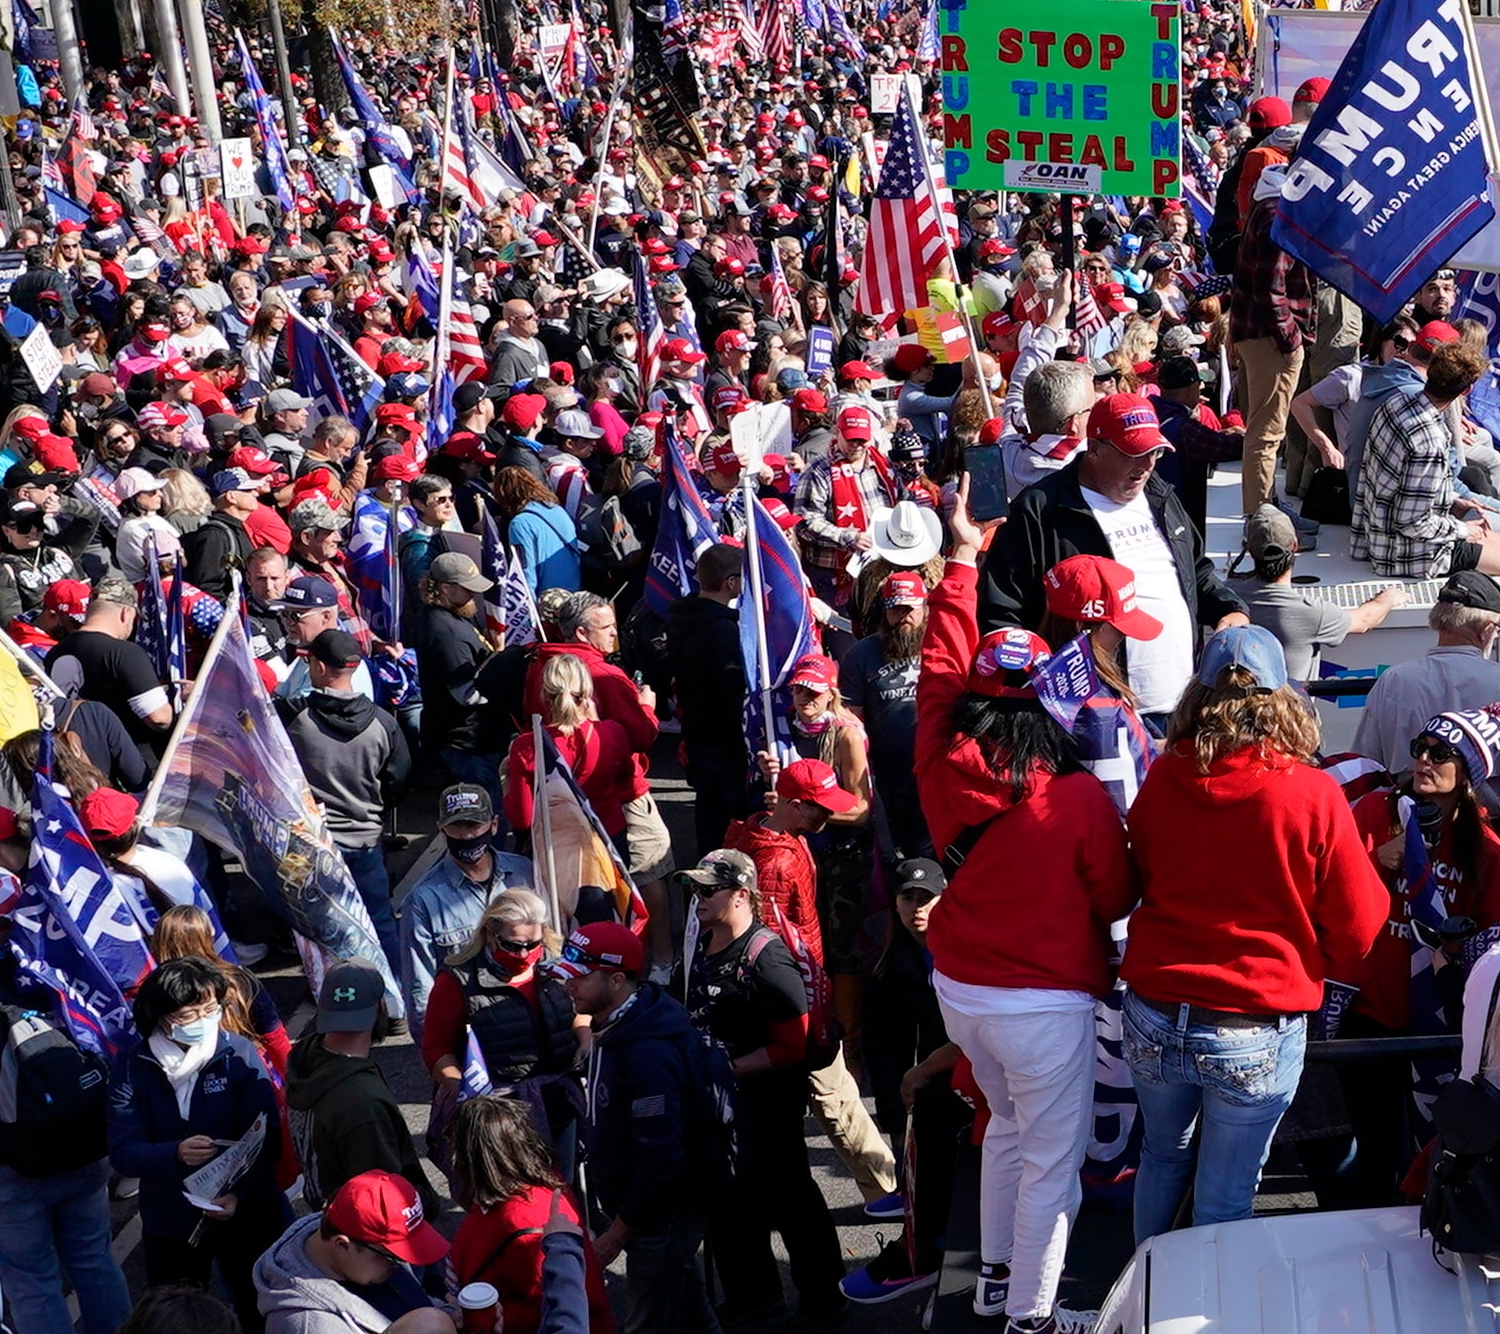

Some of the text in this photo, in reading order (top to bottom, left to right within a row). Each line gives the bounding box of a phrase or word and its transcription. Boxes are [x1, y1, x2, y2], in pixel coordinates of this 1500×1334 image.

[997, 28, 1127, 72] STOP
[1011, 80, 1110, 122] THE
[225, 141, 243, 157] WE
[984, 129, 1136, 174] STEAL
[1037, 164, 1089, 179] OAN
[25, 335, 47, 359] STOP
[1081, 599, 1105, 618] 45
[1062, 641, 1093, 701] TRUMP
